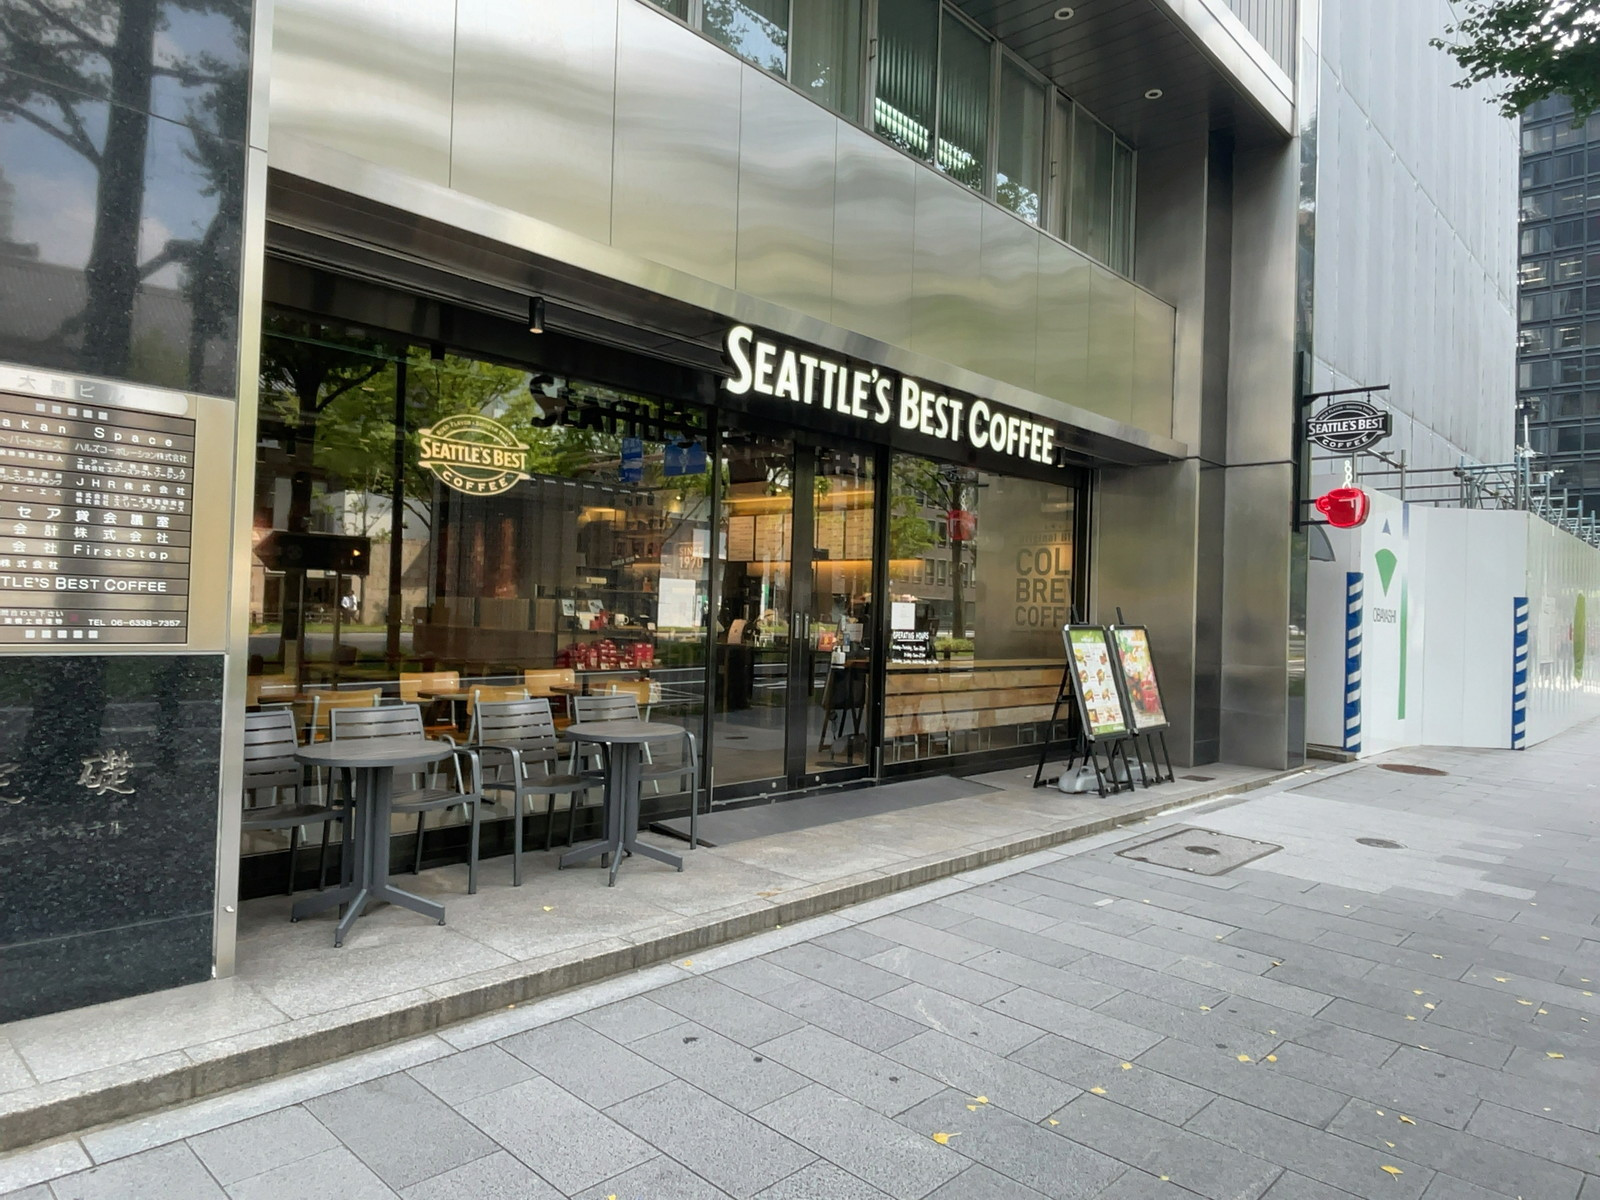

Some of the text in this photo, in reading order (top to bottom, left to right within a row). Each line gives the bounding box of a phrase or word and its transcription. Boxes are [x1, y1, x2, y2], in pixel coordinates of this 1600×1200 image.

[726, 325, 1055, 465] SEATTLE'S BEST COFFEE
[1308, 417, 1385, 435] SEATTLE'S BEST
[94, 427, 173, 447] Space
[1322, 436, 1368, 448] COFFEE
[420, 437, 492, 465] SEATTLE'S
[493, 449, 528, 471] BEST
[442, 471, 508, 492] COFFEE
[680, 556, 704, 569] 1970
[55, 577, 100, 590] BEST
[104, 579, 167, 592] COFFEE
[1016, 578, 1072, 603] BRE
[88, 618, 105, 626] TEL
